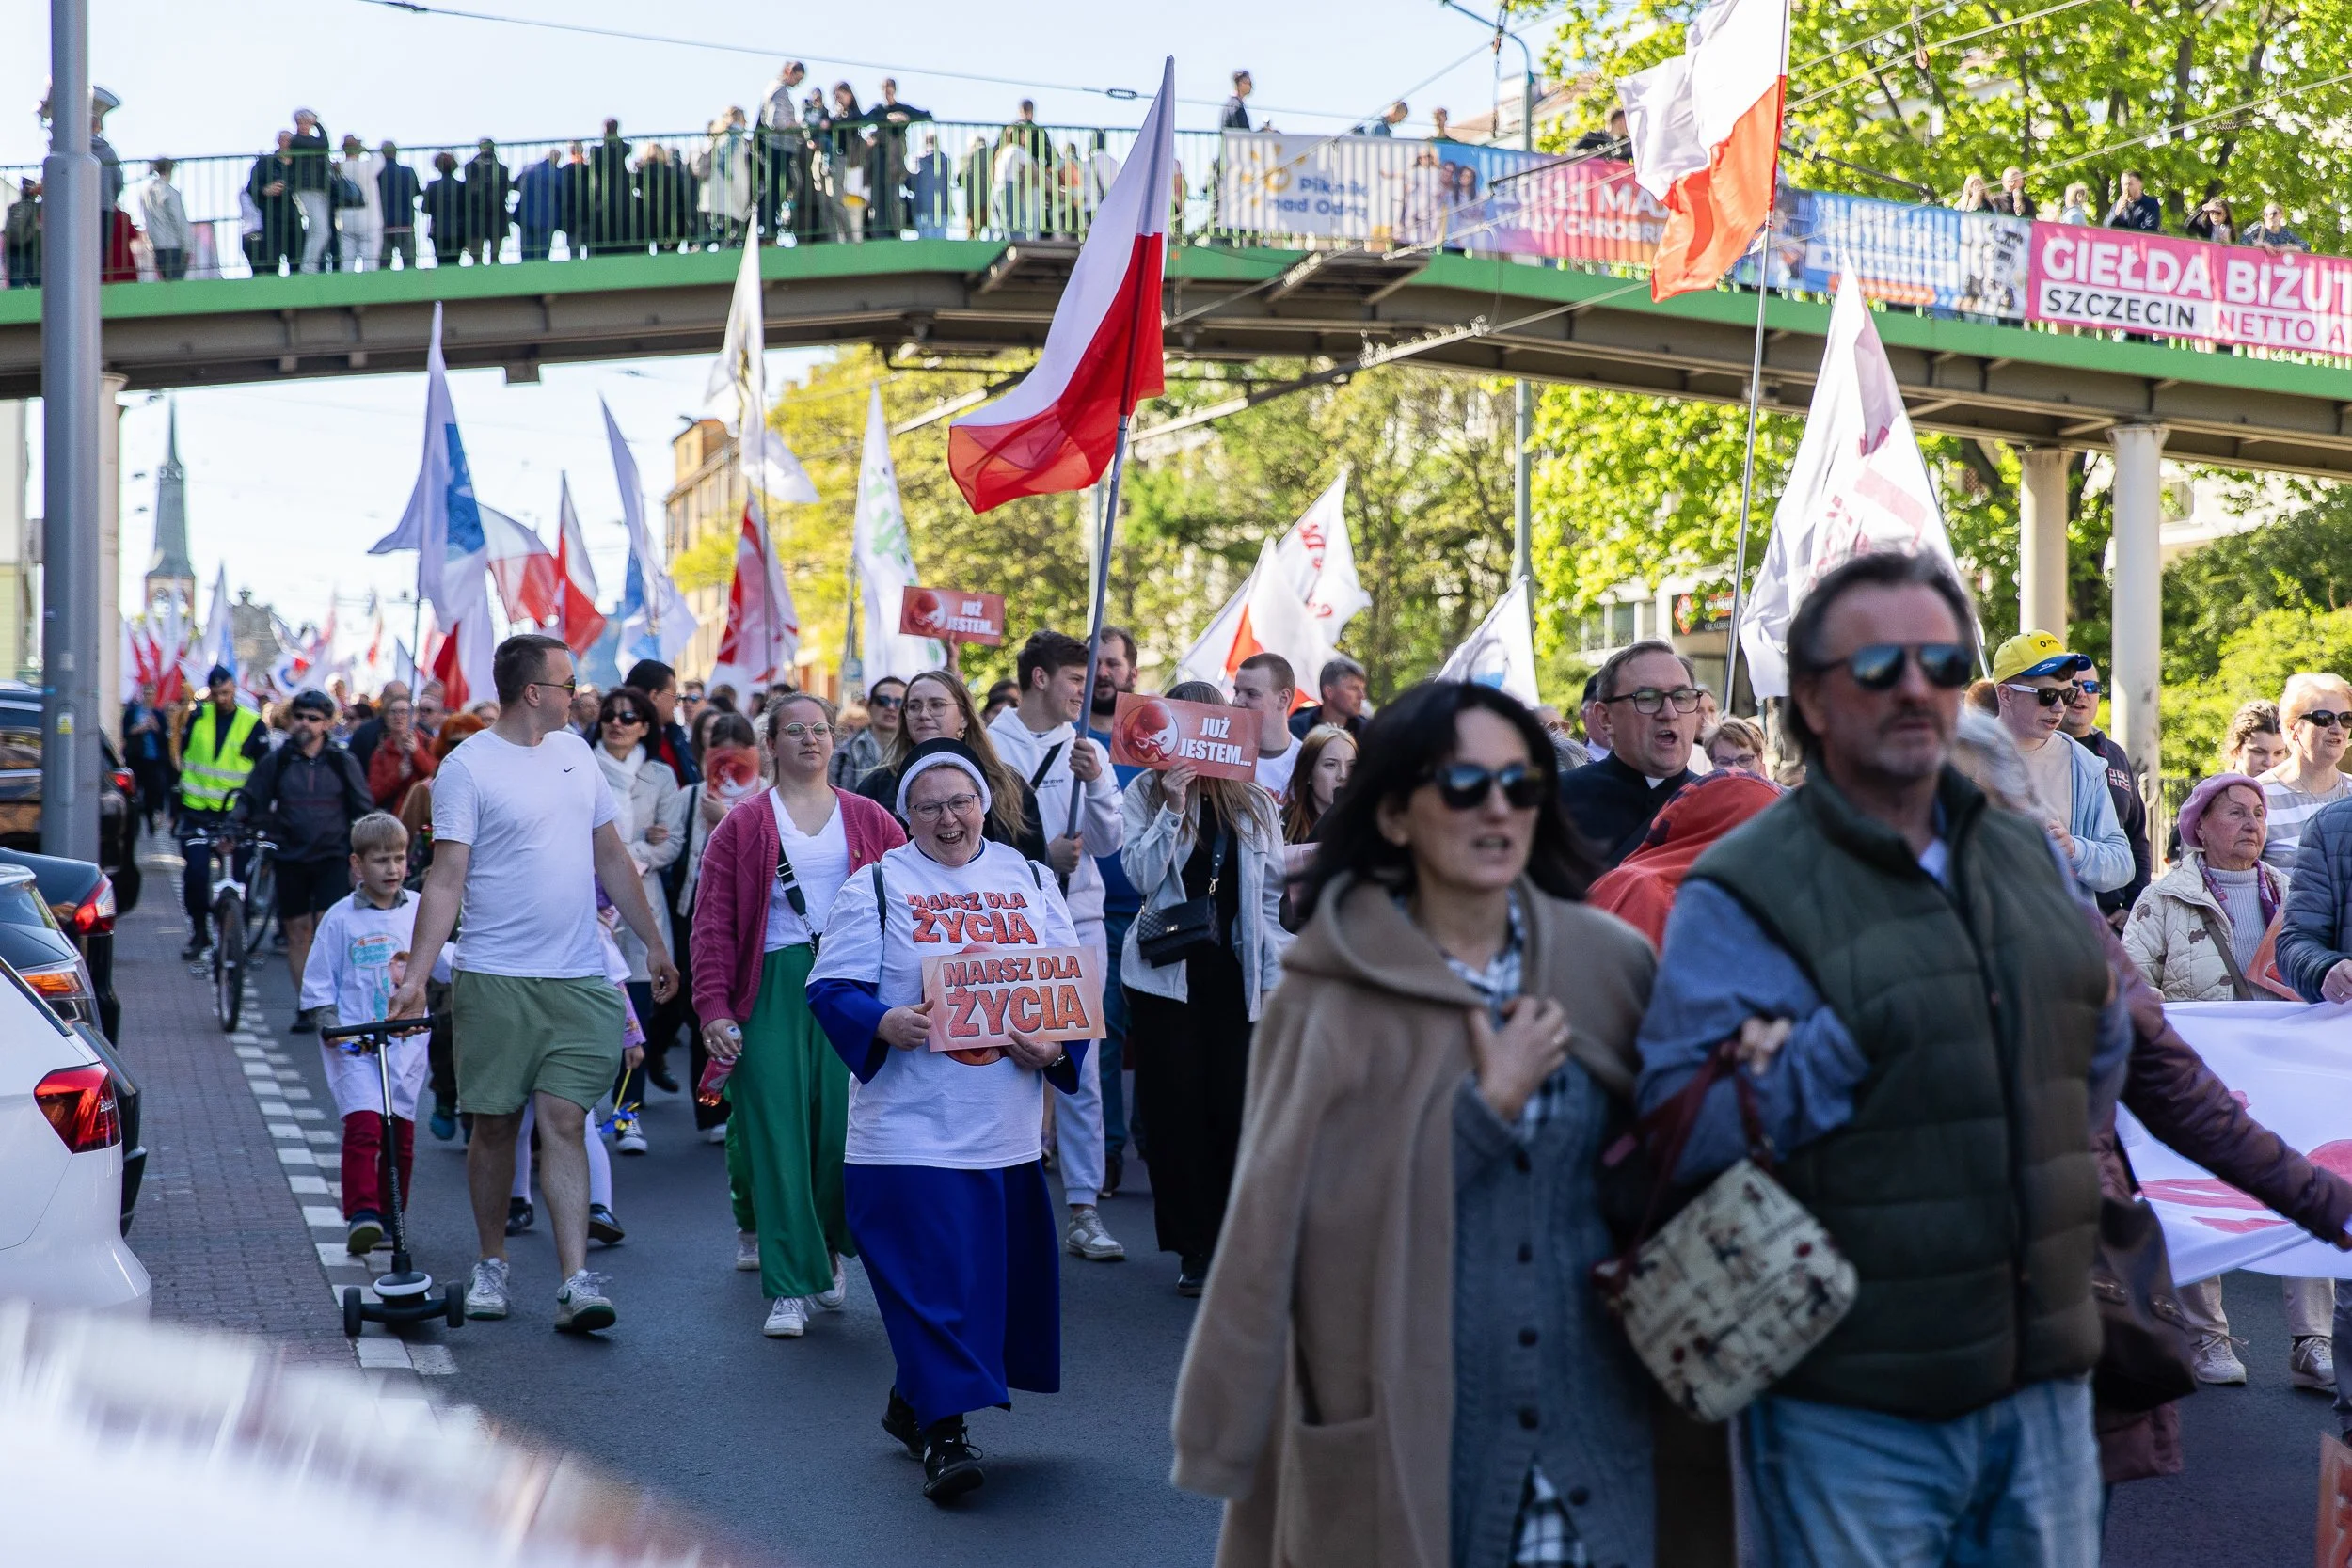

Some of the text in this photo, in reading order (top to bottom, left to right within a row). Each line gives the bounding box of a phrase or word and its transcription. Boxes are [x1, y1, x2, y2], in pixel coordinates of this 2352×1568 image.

[2042, 235, 2214, 301] GIEŁDA
[2047, 288, 2195, 328] SZCZECIN
[2218, 309, 2315, 342] NETTO
[1200, 716, 1231, 739] JUŻ
[1178, 737, 1252, 768] JESTEM...
[906, 891, 1029, 911] MARSZ DLA
[911, 906, 1038, 944] ŻYCIA
[943, 955, 1083, 988] MARSZ DLA
[946, 985, 1090, 1038] ŻYCIA
